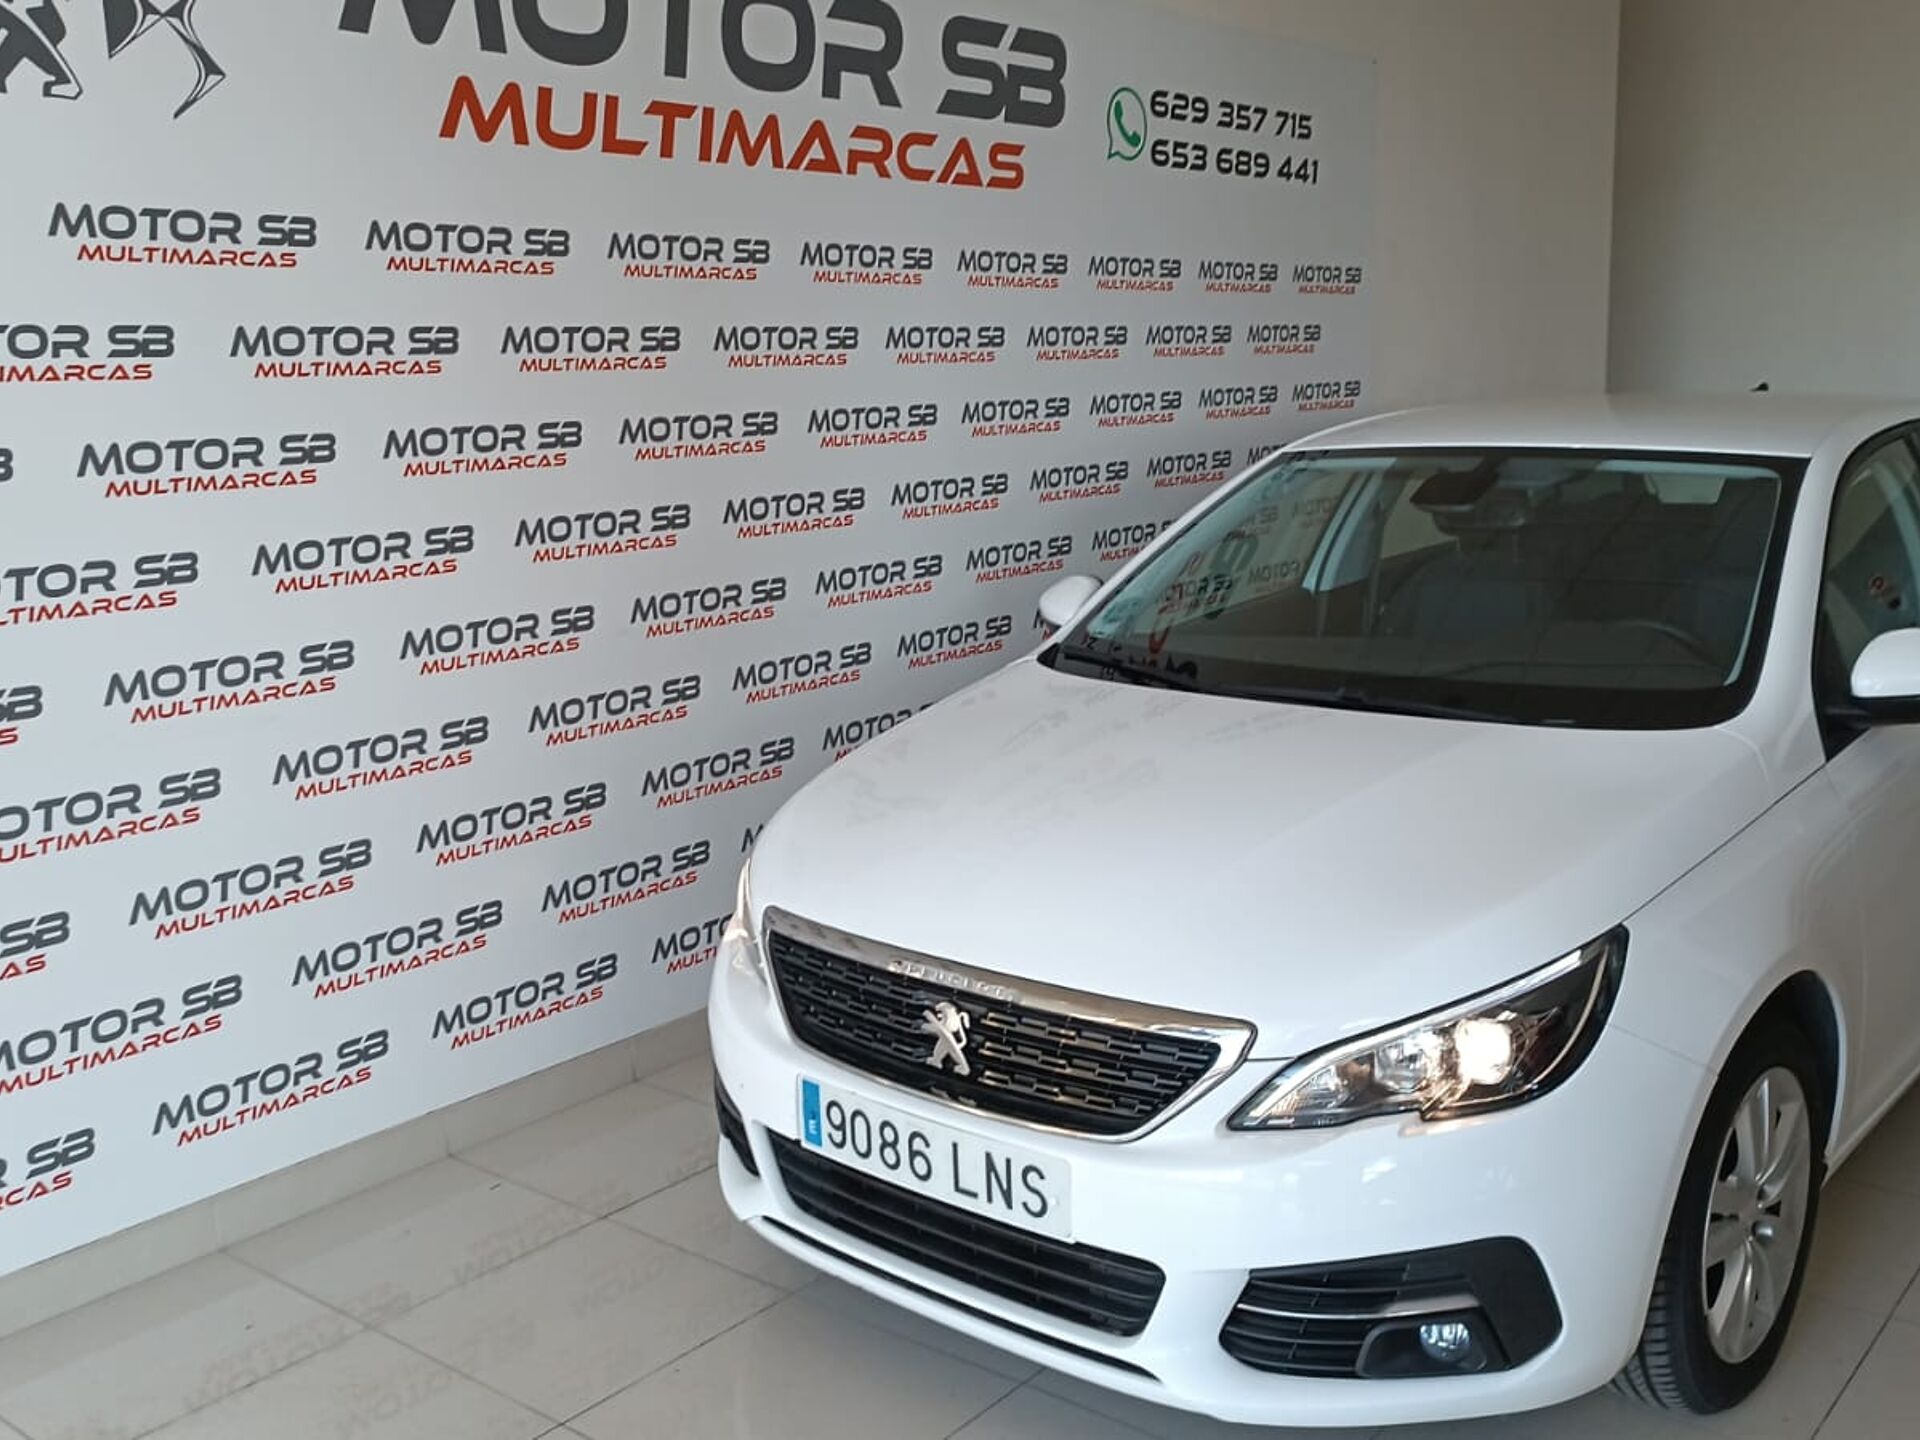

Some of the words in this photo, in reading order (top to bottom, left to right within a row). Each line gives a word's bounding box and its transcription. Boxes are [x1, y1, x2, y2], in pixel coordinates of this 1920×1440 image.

[936, 16, 1067, 128] SB
[439, 75, 1026, 189] MULTIMARCAS
[1150, 90, 1209, 123] 629
[1216, 101, 1267, 132] 357
[1275, 110, 1313, 140] 715
[1150, 139, 1207, 171] 653
[1216, 148, 1270, 178] 689
[1277, 156, 1319, 184] 441
[48, 203, 242, 244] MOTOR
[257, 215, 316, 247] SB
[365, 220, 512, 255] MOTOR
[523, 229, 569, 257] SB
[77, 244, 297, 269] MULTIMARCAS
[386, 255, 555, 276] MULTIMARCAS
[607, 233, 723, 263] MOTOR
[732, 239, 770, 264] SB
[800, 242, 895, 269] MOTOR
[902, 247, 933, 270] SB
[957, 250, 1035, 274] MOTOR
[1043, 253, 1068, 275] SB
[623, 262, 757, 281] MULTIMARCAS
[813, 269, 923, 289] MULTIMARCAS
[1088, 256, 1155, 278] MOTOR
[1159, 258, 1181, 278] SB
[1198, 260, 1255, 281] MOTOR
[1259, 262, 1278, 281] SB
[1292, 265, 1342, 284] MOTOR
[1345, 266, 1362, 284] SB
[107, 325, 174, 358] SB
[230, 326, 395, 357] MOTOR
[408, 326, 459, 356] SB
[501, 326, 630, 354] MOTOR
[639, 326, 681, 352] SB
[713, 326, 817, 351] MOTOR
[825, 326, 859, 350] SB
[885, 326, 972, 349] MOTOR
[977, 326, 1005, 348] SB
[1027, 325, 1098, 348] MOTOR
[1104, 325, 1128, 347] SB
[1145, 325, 1207, 345] MOTOR
[1212, 325, 1232, 344] SB
[1247, 324, 1300, 343] MOTOR
[1303, 324, 1321, 342] SB
[254, 358, 442, 378] MULTIMARCAS
[519, 355, 667, 373] MULTIMARCAS
[728, 353, 848, 369] MULTIMARCAS
[897, 351, 996, 365] MULTIMARCAS
[1089, 392, 1155, 416] MOTOR
[1160, 391, 1182, 410] SB
[1198, 386, 1260, 408] MOTOR
[1263, 385, 1278, 404] SB
[1291, 382, 1340, 402] MOTOR
[1343, 381, 1360, 398] SB
[619, 414, 733, 444] MOTOR
[742, 411, 778, 437] SB
[807, 406, 900, 433] MOTOR
[907, 404, 938, 427] SB
[961, 399, 1041, 424] MOTOR
[1044, 397, 1070, 418] SB
[77, 437, 264, 477] MOTOR
[279, 433, 336, 466] SB
[383, 424, 526, 459] MOTOR
[537, 421, 582, 450] SB
[634, 439, 766, 462] MULTIMARCAS
[820, 429, 927, 450] MULTIMARCAS
[403, 452, 567, 478] MULTIMARCAS
[1030, 463, 1099, 490] MOTOR
[1105, 461, 1128, 480] SB
[1147, 454, 1208, 477] MOTOR
[1212, 450, 1231, 469] SB
[105, 469, 317, 498] MULTIMARCAS
[891, 476, 974, 506] MOTOR
[982, 473, 1008, 496] SB
[723, 491, 824, 524] MOTOR
[832, 487, 865, 512] SB
[902, 498, 1001, 521] MULTIMARCAS
[515, 509, 641, 547] MOTOR
[650, 504, 691, 532] SB
[737, 513, 856, 539] MULTIMARCAS
[1092, 523, 1156, 551] MOTOR
[252, 531, 411, 576] MOTOR
[424, 525, 474, 557] SB
[533, 534, 677, 564] MULTIMARCAS
[966, 540, 1042, 572] MOTOR
[1047, 535, 1073, 557] SB
[133, 552, 198, 589] SB
[275, 558, 457, 593] MULTIMARCAS
[815, 560, 906, 595] MOTOR
[913, 554, 943, 579] SB
[631, 584, 742, 624] MOTOR
[751, 577, 786, 605] SB
[827, 580, 933, 609] MULTIMARCAS
[400, 613, 539, 660] MOTOR
[550, 605, 594, 636] SB
[646, 605, 776, 638] MULTIMARCAS
[897, 623, 978, 658] MOTOR
[985, 615, 1012, 640] SB
[421, 636, 580, 675] MULTIMARCAS
[732, 653, 831, 691] MOTOR
[840, 642, 872, 669] SB
[907, 639, 1004, 669] MULTIMARCAS
[104, 651, 284, 706] MOTOR
[298, 640, 354, 676] SB
[745, 669, 862, 705] MULTIMARCAS
[130, 675, 336, 724] MULTIMARCAS
[528, 684, 651, 733] MOTOR
[662, 675, 701, 706] SB
[545, 704, 688, 747] MULTIMARCAS
[273, 728, 427, 785] MOTOR
[440, 716, 488, 751] SB
[641, 747, 750, 797] MOTOR
[759, 736, 795, 766] SB
[158, 768, 220, 809] SB
[295, 749, 472, 801] MULTIMARCAS
[655, 764, 783, 809] MULTIMARCAS
[416, 796, 552, 853] MOTOR
[563, 782, 606, 816] SB
[436, 813, 592, 866] MULTIMARCAS
[129, 856, 304, 925] MOTOR
[318, 839, 371, 878] SB
[541, 855, 661, 912] MOTOR
[672, 839, 710, 873] SB
[155, 875, 355, 939] MULTIMARCAS
[559, 868, 699, 923] MULTIMARCAS
[292, 918, 443, 986] MOTOR
[455, 900, 502, 938] SB
[314, 933, 487, 999] MULTIMARCAS
[181, 975, 242, 1020] SB
[432, 966, 565, 1038] MOTOR
[575, 953, 618, 988] SB
[451, 985, 603, 1049] MULTIMARCAS
[153, 1053, 322, 1135] MOTOR
[336, 1030, 388, 1072] SB
[177, 1066, 372, 1147] MULTIMARCAS
[26, 1128, 95, 1180] SB
[826, 1100, 932, 1182] 9086
[952, 1141, 1049, 1218] LNS
